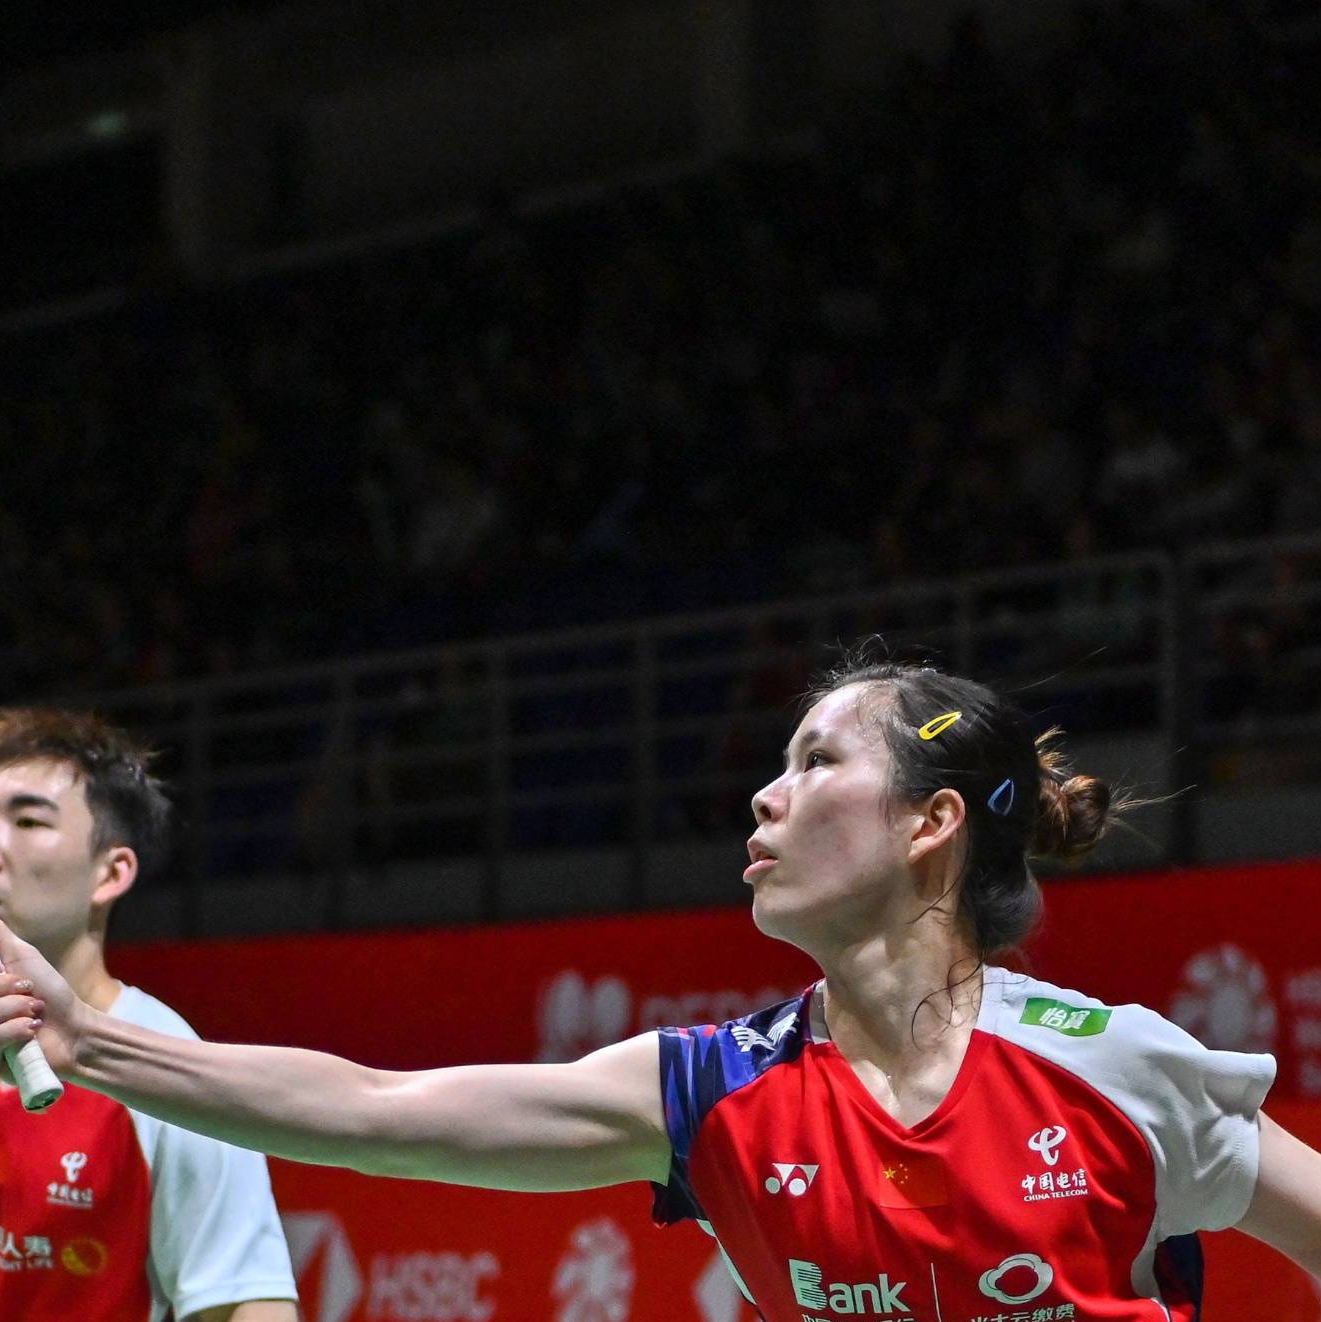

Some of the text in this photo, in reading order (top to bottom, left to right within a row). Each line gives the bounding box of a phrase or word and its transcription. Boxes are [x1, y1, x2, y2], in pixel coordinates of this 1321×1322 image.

[1022, 1168, 1087, 1195] 中国电信
[1023, 1188, 1088, 1202] CHINA TELECOM
[789, 1258, 911, 1314] Bank
